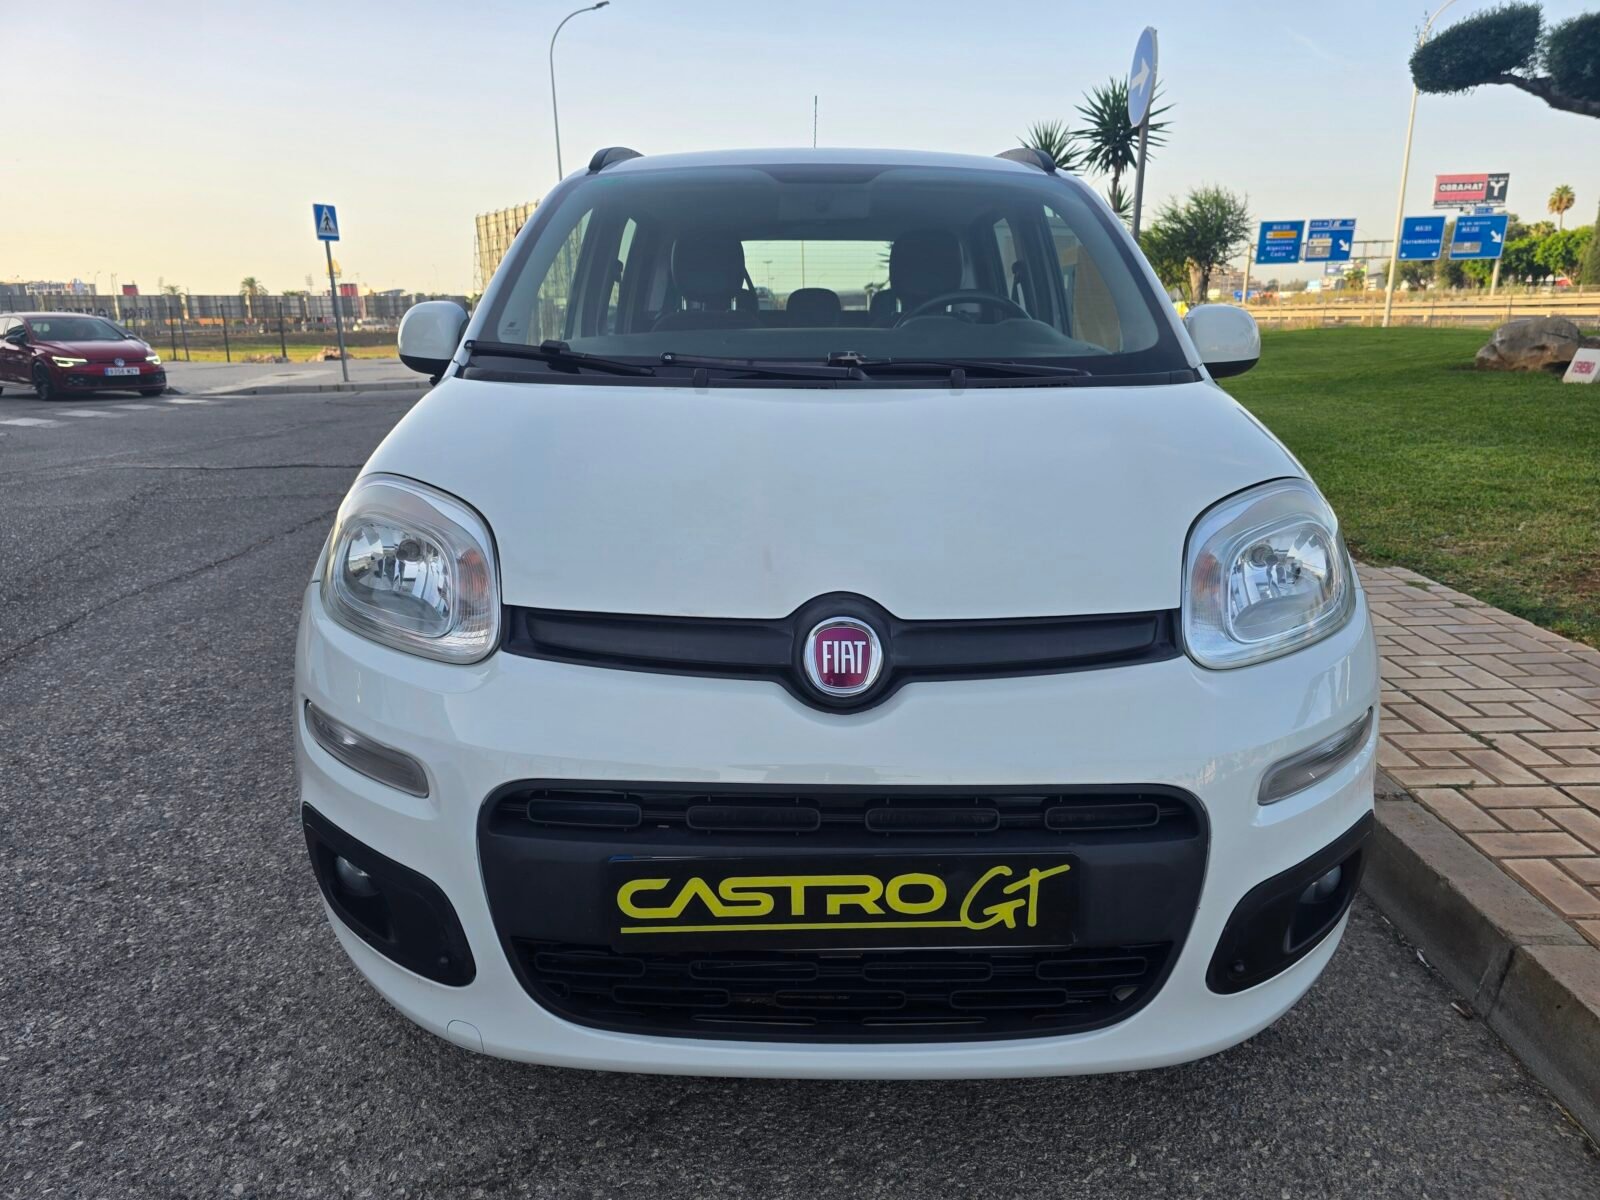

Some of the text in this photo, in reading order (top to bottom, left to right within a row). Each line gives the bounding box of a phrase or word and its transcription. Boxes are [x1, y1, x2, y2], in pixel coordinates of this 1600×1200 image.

[1440, 182, 1484, 192] OBRAMAT
[822, 640, 866, 674] FIAT
[617, 864, 1071, 931] CASTRO GT
